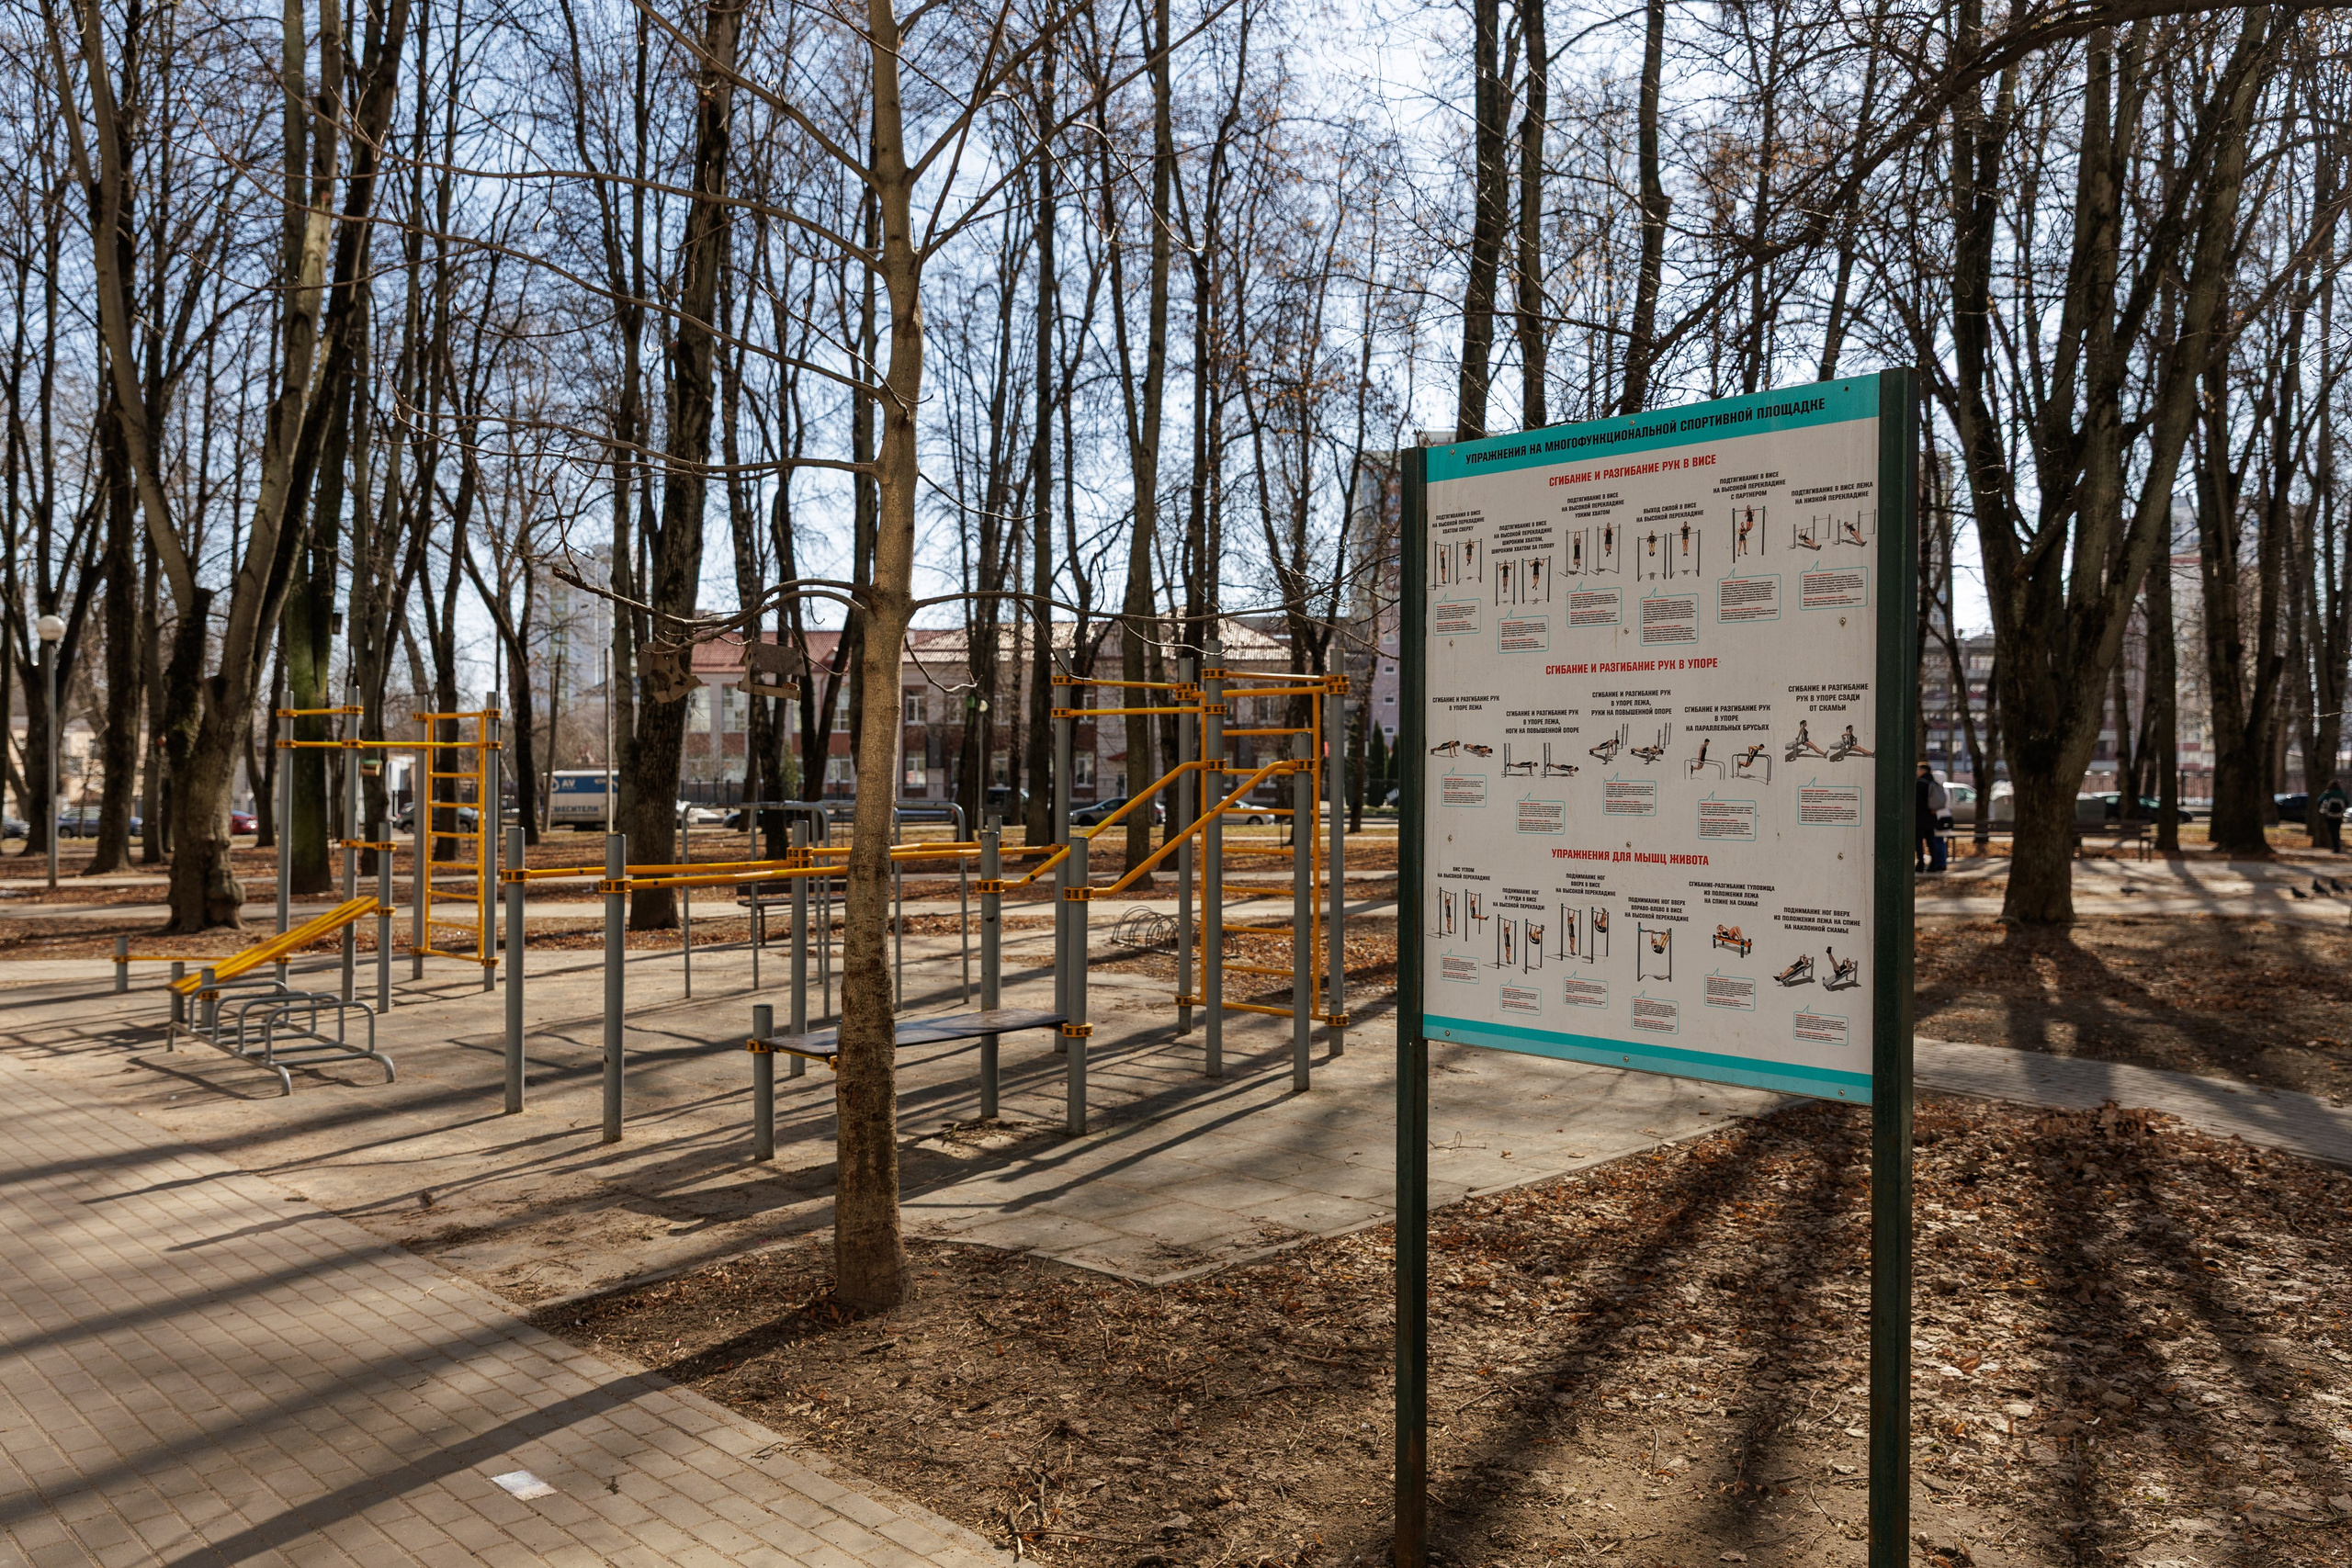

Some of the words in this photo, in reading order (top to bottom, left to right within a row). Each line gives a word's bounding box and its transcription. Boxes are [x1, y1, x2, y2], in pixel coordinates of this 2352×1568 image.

[1465, 445, 1527, 465] УПРАЖНЕНИЯ
[1530, 443, 1542, 455] НА
[1544, 419, 1677, 453] МНОГОФУНКЦИОНАЛЬНОЙ
[1680, 407, 1753, 432] СПОРТИВНОЙ
[1757, 398, 1826, 420] ПЛОЩАДКЕ
[1549, 471, 1592, 487] СГИБАНИЕ
[1594, 470, 1600, 480] И
[1603, 462, 1659, 479] РАЗГИБАНИЕ
[1662, 459, 1680, 471] РУК
[1683, 458, 1690, 468] В
[1692, 454, 1716, 468] ВИСЕ
[1719, 473, 1759, 485] ПОДТЯГИВАНИЕ
[1721, 482, 1747, 493] ВЫСОКОЙ
[1747, 479, 1786, 490] ПЕРЕКЛАДИНЕ
[1791, 485, 1834, 497] ПОДТЯГИВАНИЕ
[1840, 483, 1855, 491] ВИСЕ
[1856, 481, 1873, 490] ЛЕЖА
[1566, 494, 1601, 504] ПОДТЯГИВАНИЕ
[1736, 490, 1768, 500] ПАРТНЕРОМ
[1804, 494, 1827, 504] НИЗКОЙ
[1827, 491, 1869, 502] ПЕРЕКЛАДИНЕ
[1568, 502, 1591, 512] ВЫСОКОЙ
[1591, 499, 1624, 509] ПЕРЕКЛАДИНЕ
[1643, 506, 1661, 514] ВЫХОД
[1661, 503, 1679, 513] СИЛОЙ
[1683, 502, 1697, 510] ВИСЕ
[1644, 513, 1668, 523] ВЫСОКОЙ
[1668, 509, 1704, 519] ПЕРЕКЛАДИНЕ
[1498, 522, 1532, 531] ПОДТЯГИВАНИЕ
[1500, 530, 1521, 539] ВЫСОКОЙ
[1521, 526, 1553, 536] ПЕРЕКЛАДИНЕ
[1491, 547, 1513, 555] ШИРОКИМ
[1545, 663, 1589, 675] СГИБАНИЕ
[1590, 663, 1597, 673] И
[1600, 660, 1656, 673] РАЗГИБАНИЕ
[1657, 660, 1676, 671] РУК
[1679, 660, 1685, 670] В
[1687, 658, 1718, 669] УПОРЕ
[1788, 684, 1820, 693] СГИБАНИЕ
[1827, 682, 1869, 692] РАЗГИБАНИЕ
[1624, 689, 1659, 697] РАЗГИБАНИЕ
[1815, 694, 1837, 702] УПОРЕ
[1838, 694, 1860, 702] СЗАДИ
[1614, 707, 1653, 716] ПОВЫШЕННОЙ
[1818, 704, 1847, 712] СКАМЬИ
[1526, 726, 1562, 734] ПОВЫШЕННОЙ
[1694, 724, 1742, 732] ПАРАЛЛЕЛЬНЫХ
[561, 779, 576, 788] AV
[1551, 849, 1610, 861] УПРАЖНЕНИЯ
[1611, 852, 1632, 863] ДЛЯ
[1634, 852, 1668, 865] МЫШЦ
[1669, 853, 1709, 866] ЖИВОТА
[1689, 881, 1746, 890] СГИБАНИЕ-РАЗГИБАНИЕ
[1747, 884, 1775, 892] ТУЛОВИЩА
[1584, 889, 1616, 897] ПЕРЕКЛАДИНЕ
[1628, 897, 1660, 905] ПОДНИМАНИЕ
[1737, 899, 1758, 908] СКАМЬЕ
[1631, 904, 1665, 913] ВПРАВО-ВЛЕВО
[1783, 907, 1821, 915] ПОДНИМАНИЕ
[1833, 909, 1850, 918] ВВЕРХ
[1655, 914, 1689, 922] ПЕРЕКЛАДИНЕ
[1781, 915, 1815, 923] ПОЛОЖЕНИЯ
[1792, 924, 1826, 932] НАКЛОННОЙ
[1826, 926, 1849, 934] СКАМЬЕ
